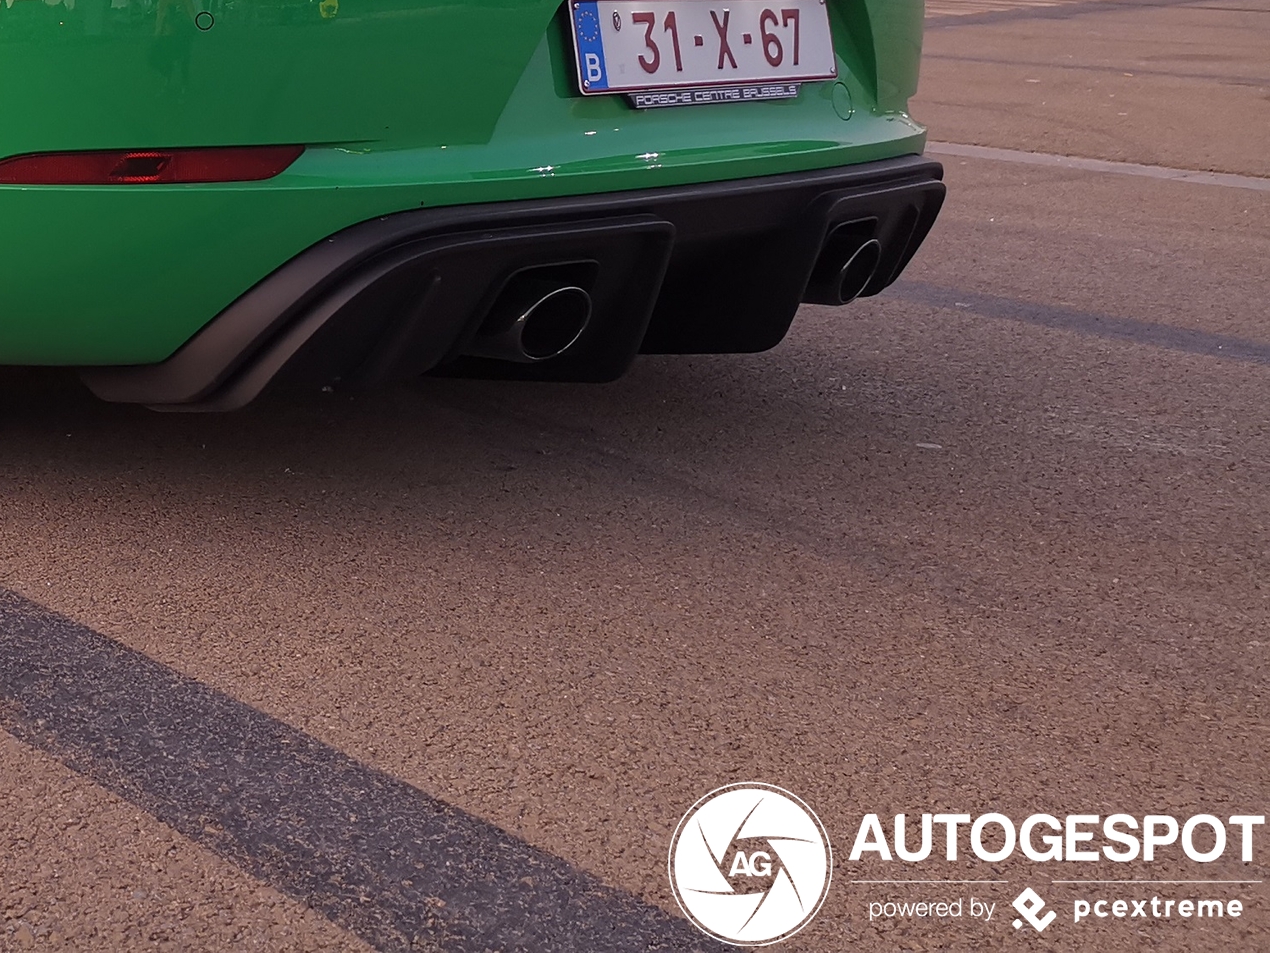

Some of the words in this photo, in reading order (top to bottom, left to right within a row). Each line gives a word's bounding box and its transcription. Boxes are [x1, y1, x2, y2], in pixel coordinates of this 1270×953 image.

[632, 8, 800, 74] 31-X-67
[585, 53, 602, 82] B
[636, 93, 692, 106] PORSCHE
[695, 90, 741, 102] CENTRE
[743, 85, 797, 98] BRUSSELS
